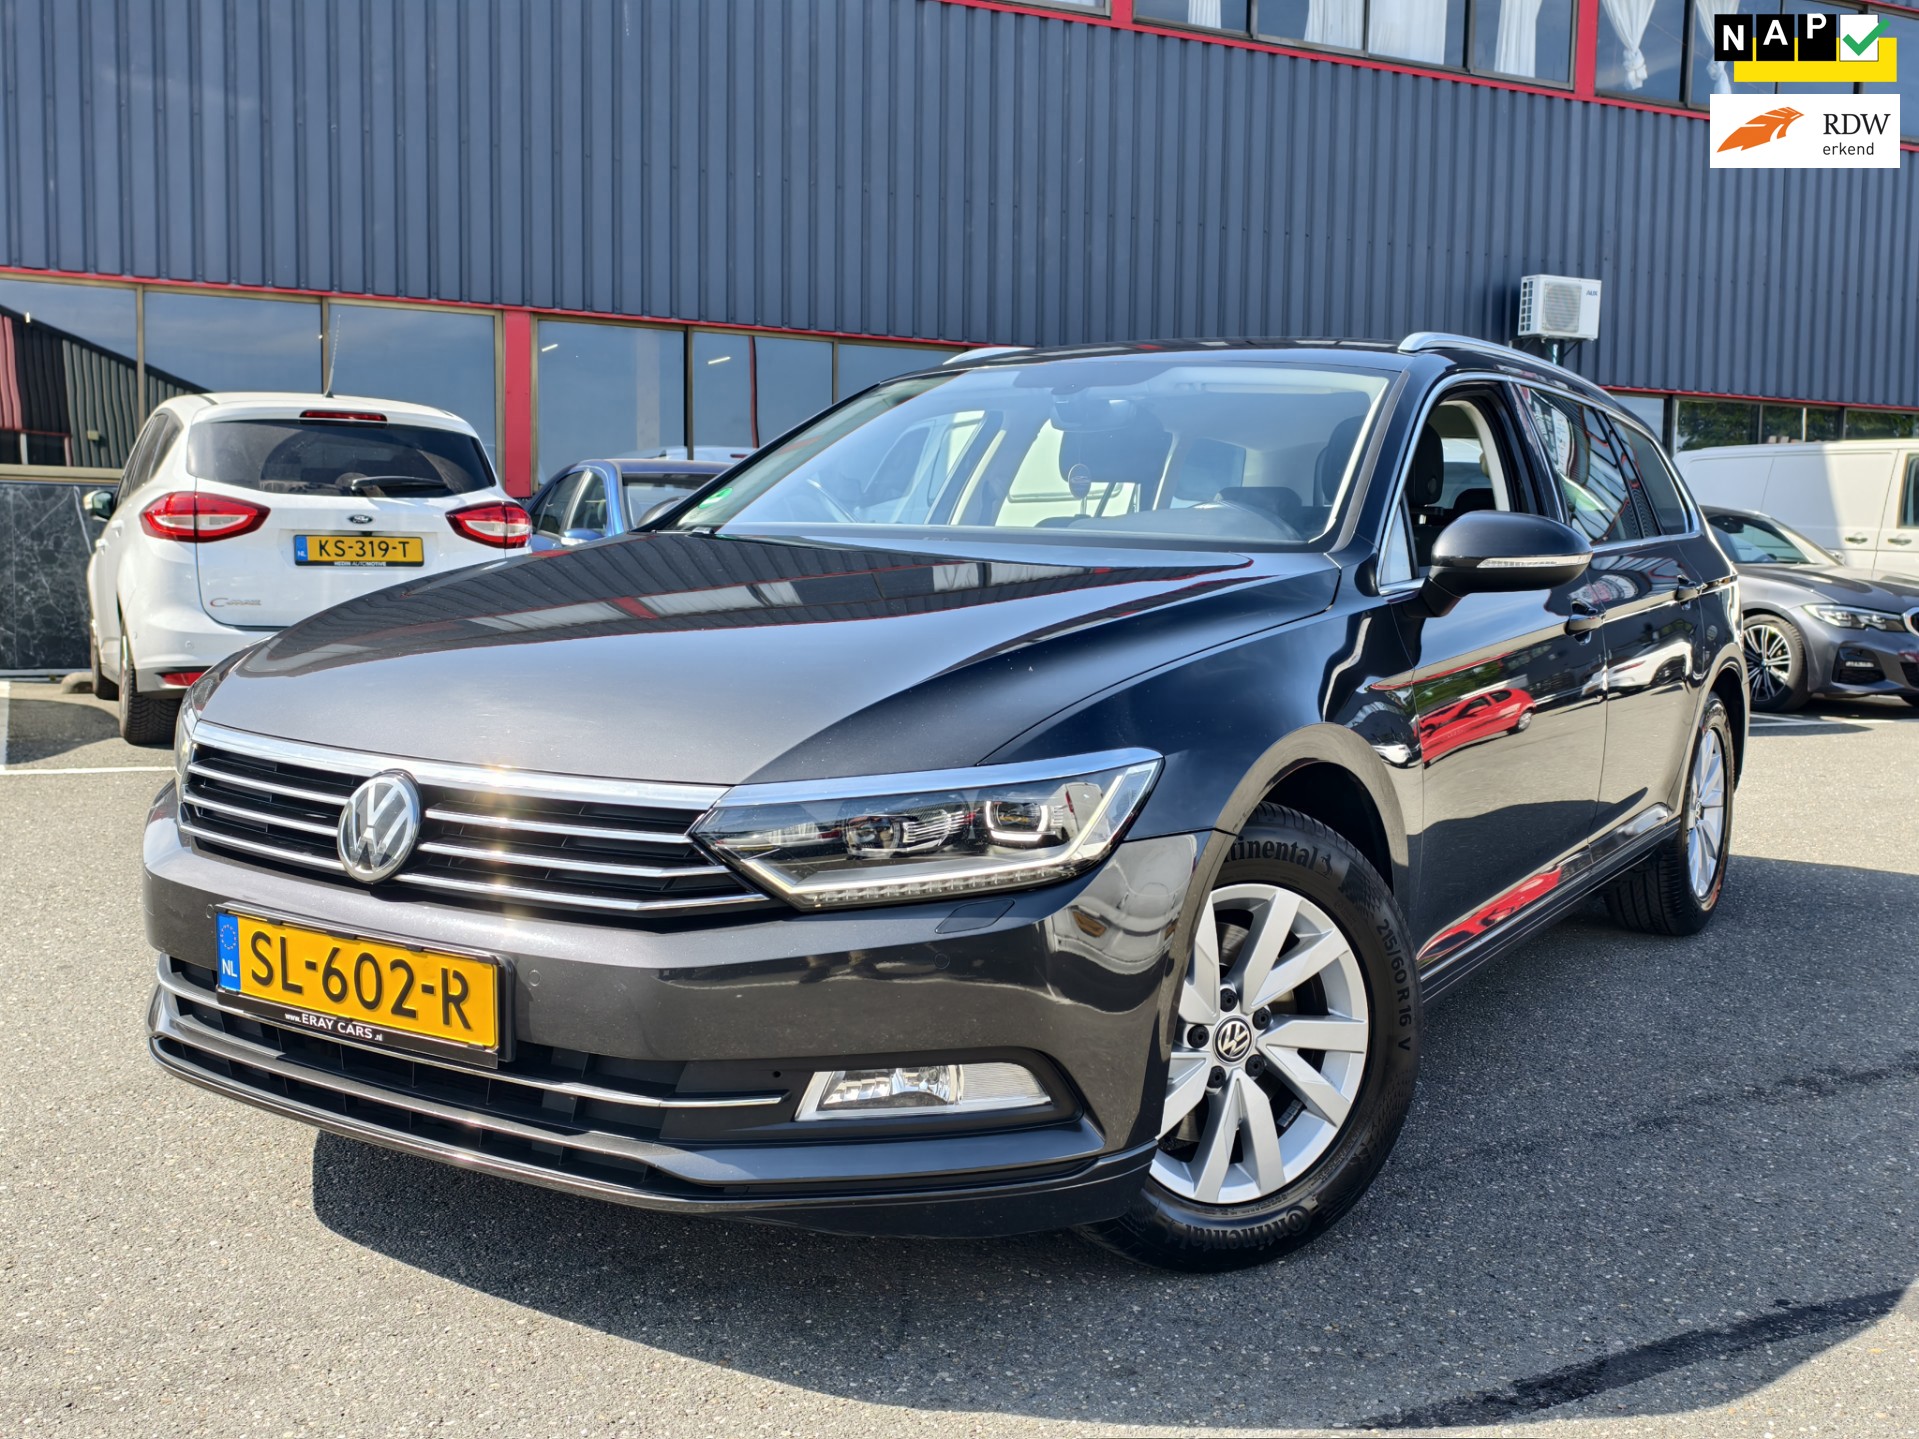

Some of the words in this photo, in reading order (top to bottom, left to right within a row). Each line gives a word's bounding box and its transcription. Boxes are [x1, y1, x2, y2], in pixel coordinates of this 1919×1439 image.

[319, 539, 410, 558] KS-319-T
[221, 959, 238, 978] NL
[250, 930, 473, 1030] SL-602-R
